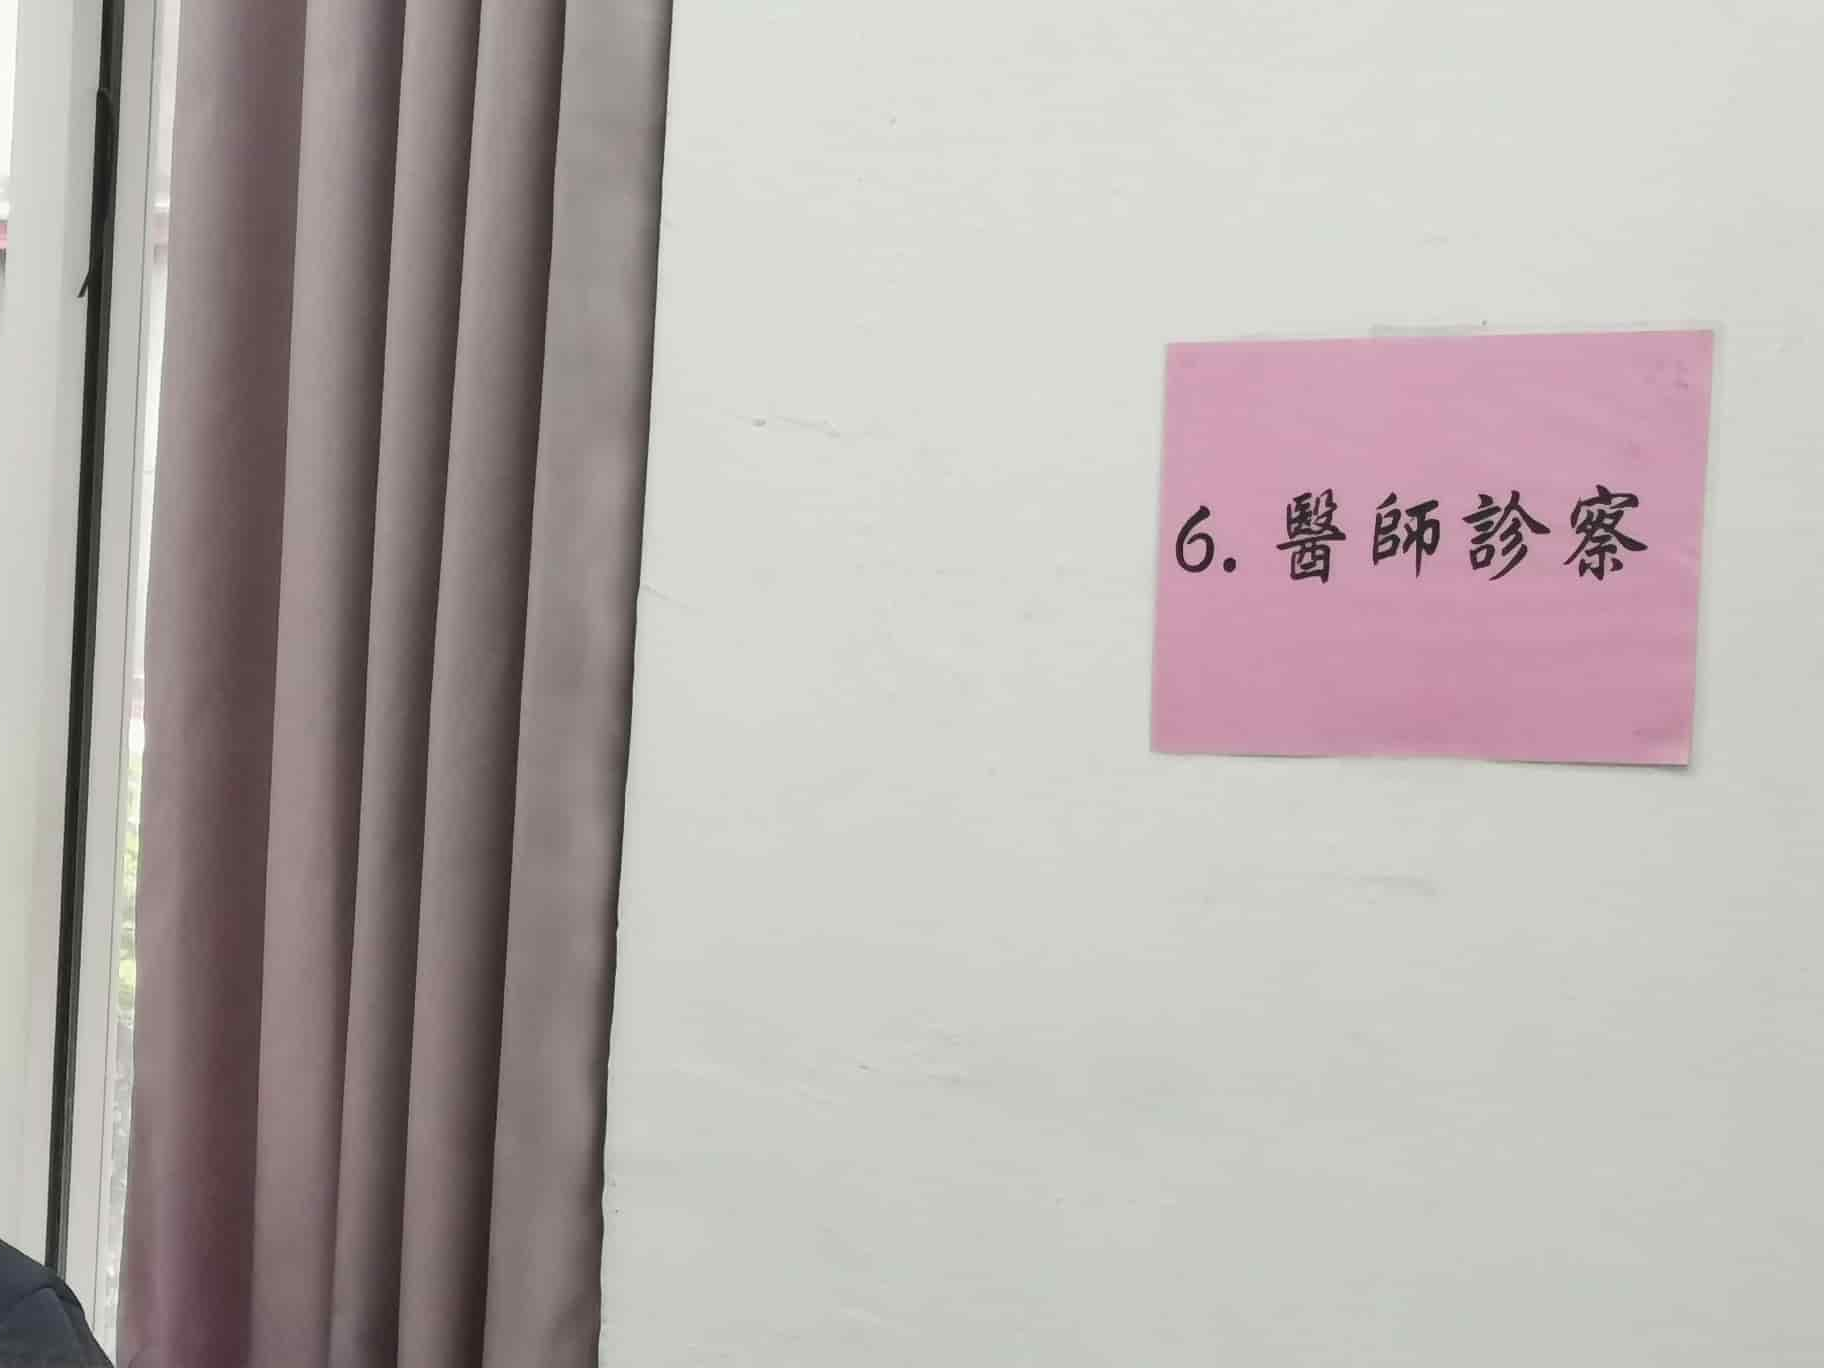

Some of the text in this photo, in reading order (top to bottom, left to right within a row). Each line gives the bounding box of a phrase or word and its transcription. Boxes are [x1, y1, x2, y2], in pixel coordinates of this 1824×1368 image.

[1175, 484, 1649, 584] 6. 醫師診察
